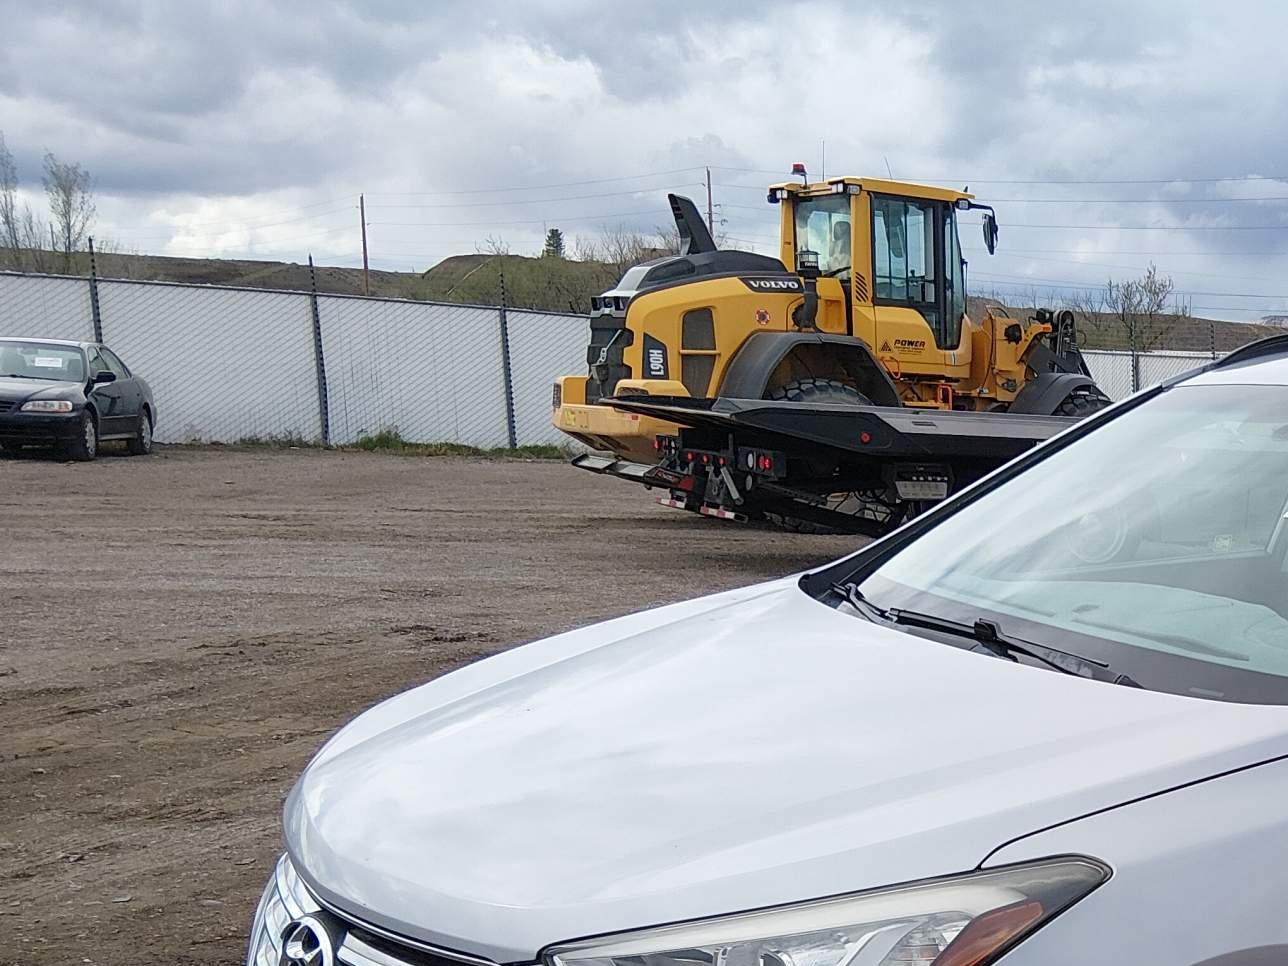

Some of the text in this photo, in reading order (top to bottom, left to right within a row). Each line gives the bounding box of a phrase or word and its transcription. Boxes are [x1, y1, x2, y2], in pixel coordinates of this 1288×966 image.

[748, 280, 799, 290] VOLVO
[894, 339, 926, 348] POWER
[648, 349, 665, 376] L90H
